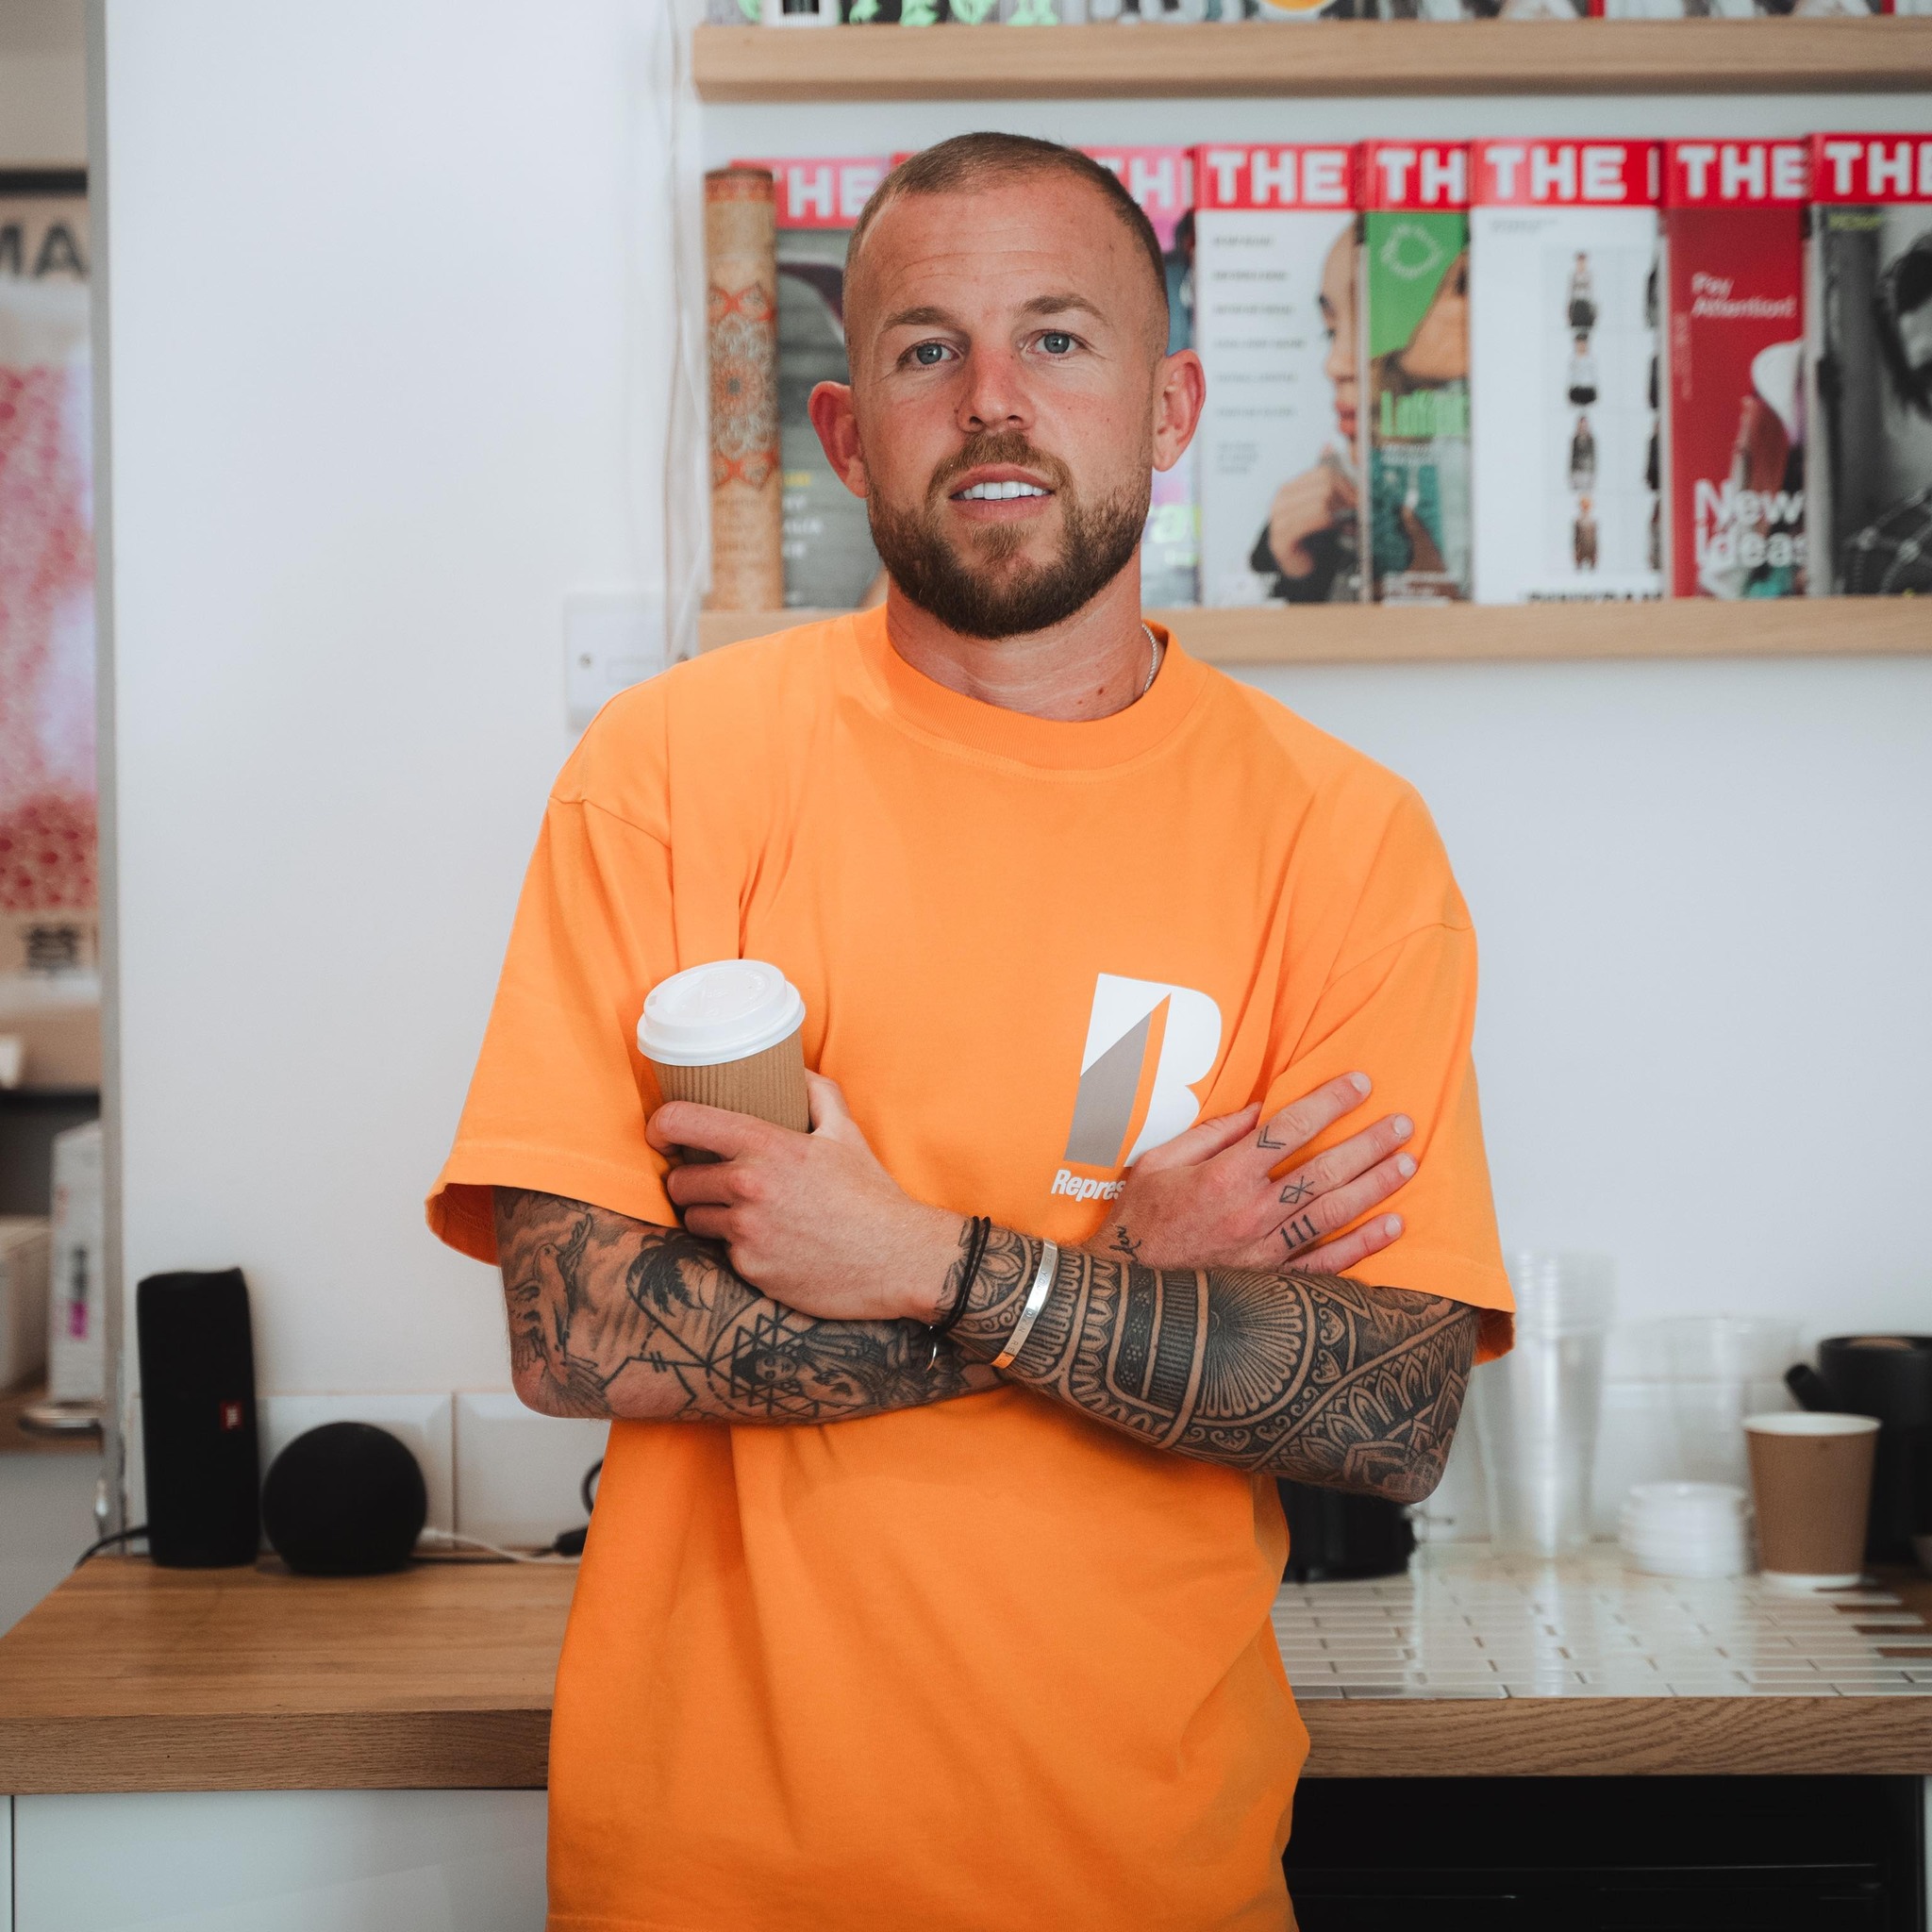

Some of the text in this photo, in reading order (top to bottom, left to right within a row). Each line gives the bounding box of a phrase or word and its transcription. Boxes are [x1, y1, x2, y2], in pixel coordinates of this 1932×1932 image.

[772, 167, 880, 218] HE
[1207, 150, 1347, 204] THE
[1485, 145, 1627, 201] THE
[1676, 145, 1804, 199] THE
[1695, 478, 1805, 525] New
